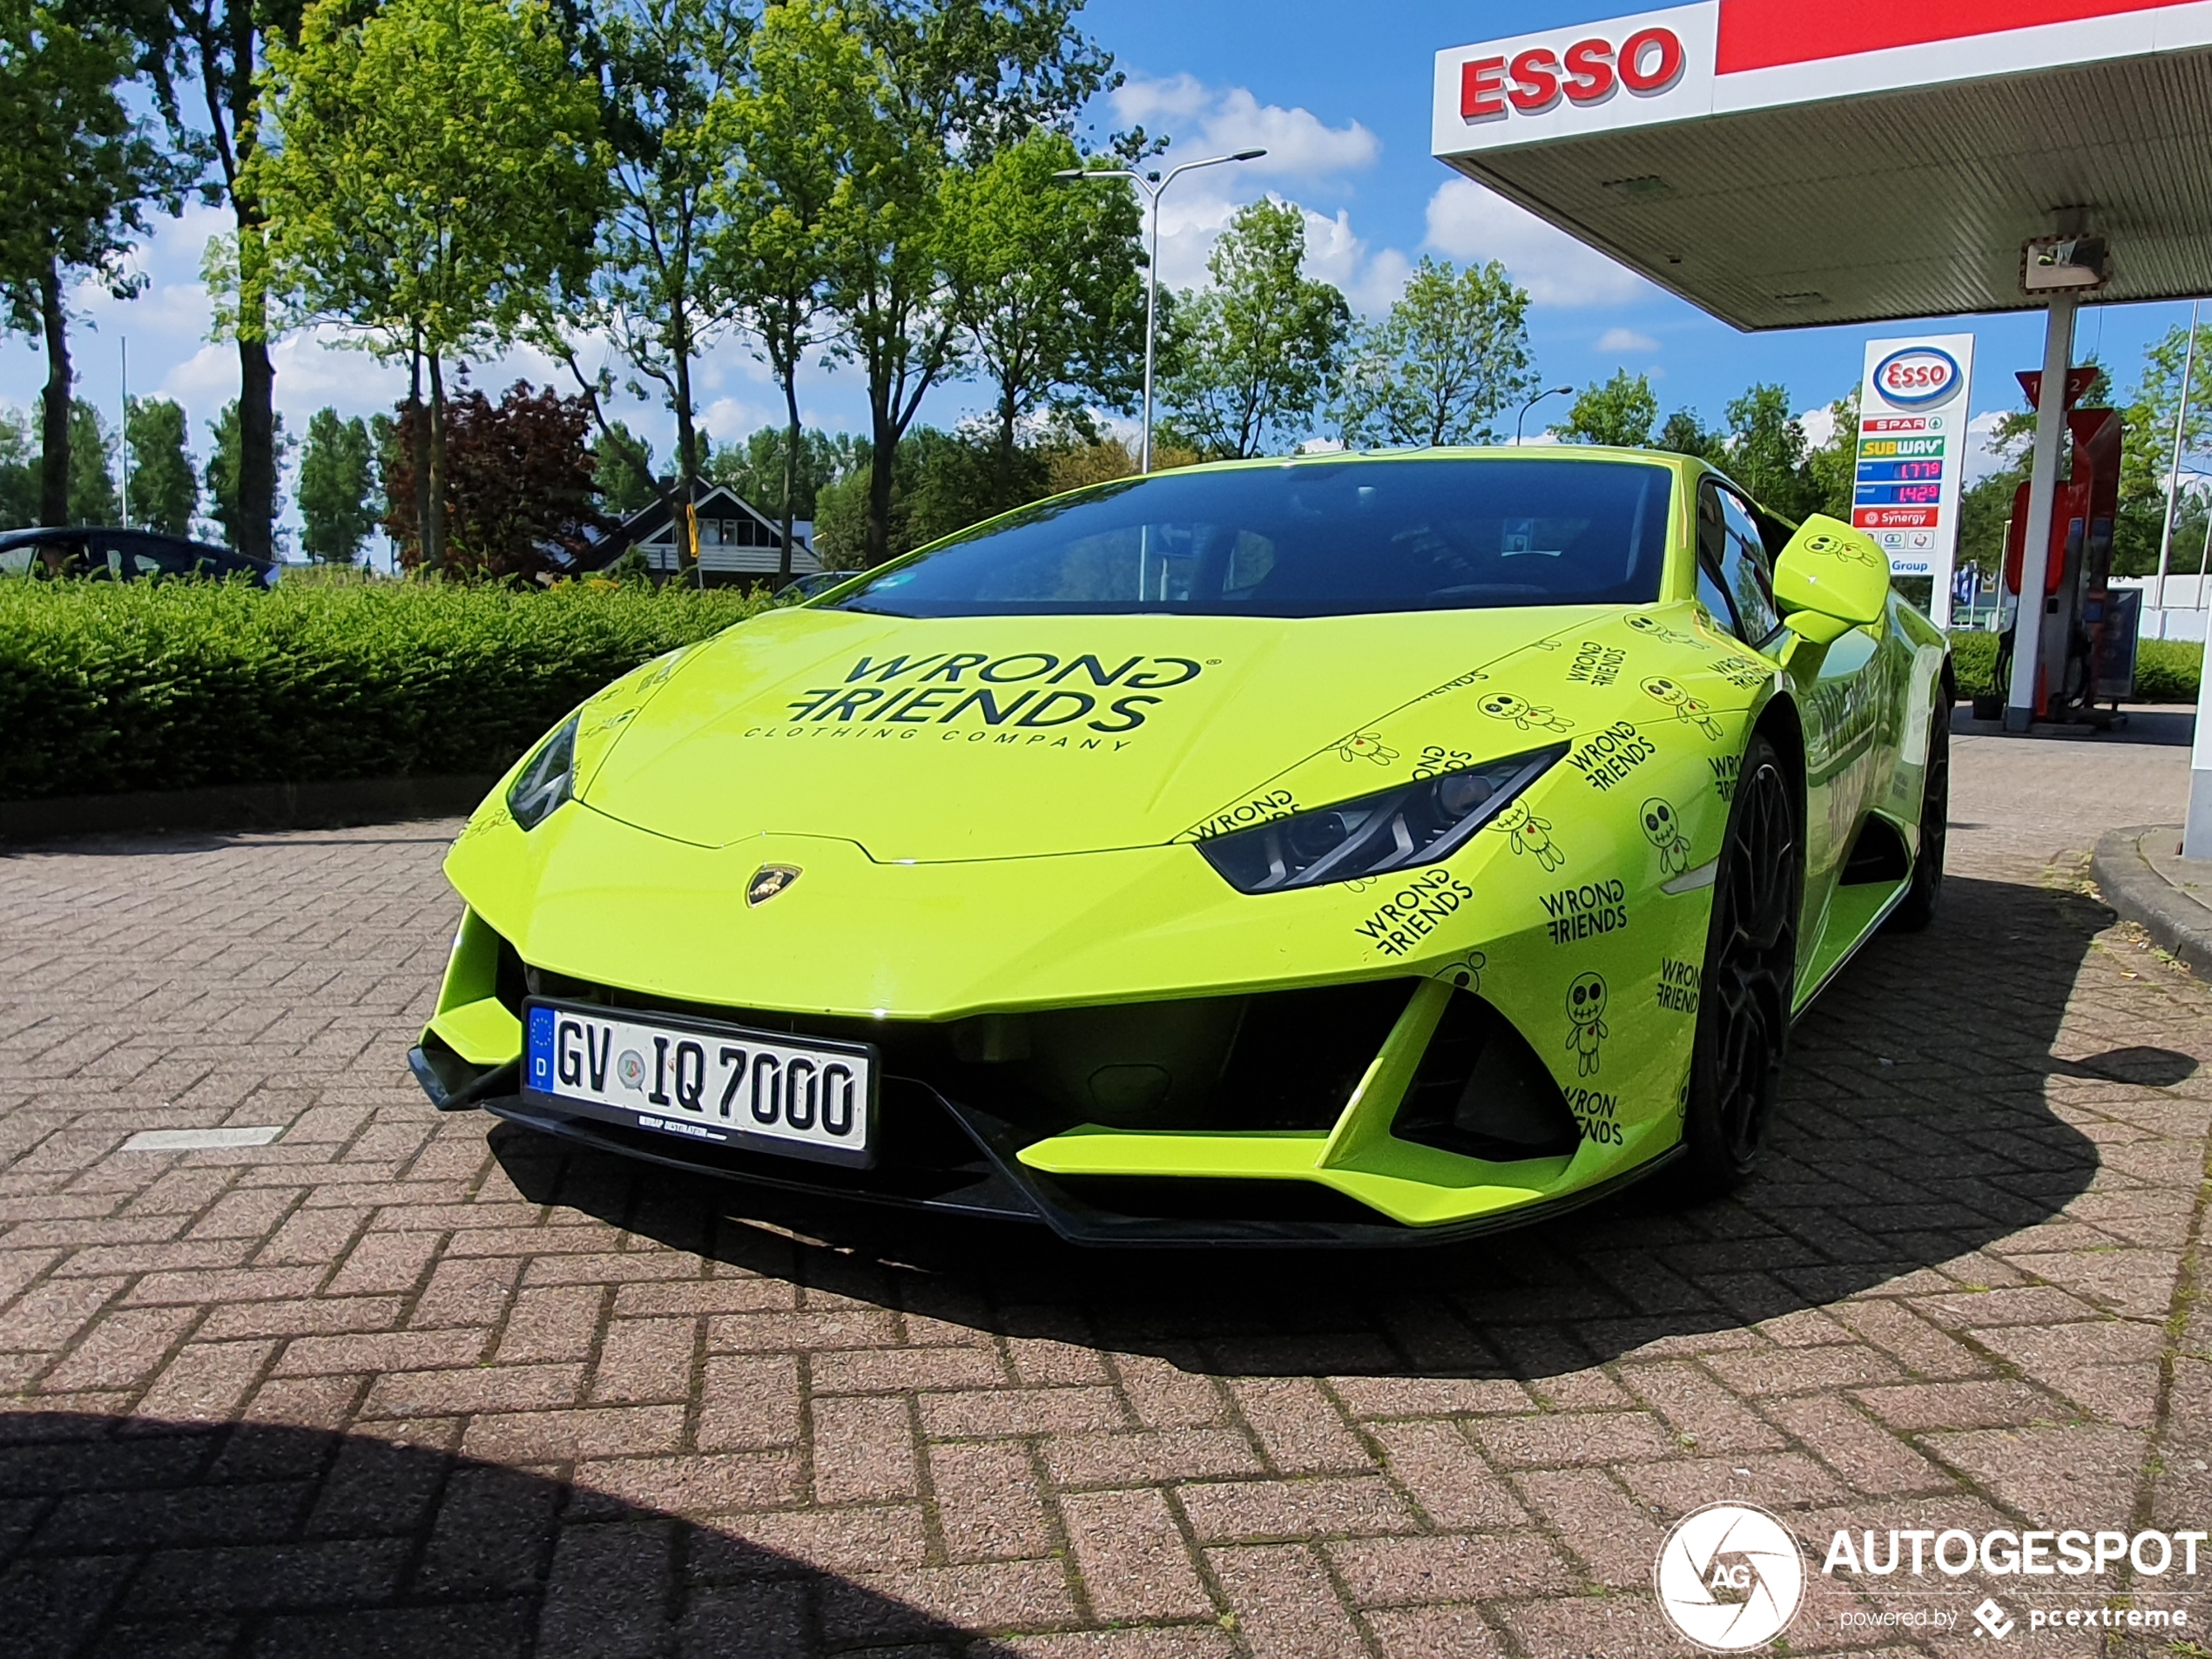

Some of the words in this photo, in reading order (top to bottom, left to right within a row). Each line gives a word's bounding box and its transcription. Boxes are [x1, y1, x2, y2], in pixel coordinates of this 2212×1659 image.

[1460, 27, 1683, 120] ESSO
[1887, 362, 1946, 387] Esso
[2031, 381, 2038, 395] 1
[2070, 378, 2080, 392] 2
[1877, 419, 1925, 430] SPAR
[1861, 439, 1943, 456] SUBWAY
[1882, 512, 1927, 525] Synergy
[1892, 560, 1928, 572] Group
[844, 652, 1202, 689] WRONG
[1566, 641, 1603, 681] WRONG
[1590, 647, 1627, 686] FRIENDS
[786, 687, 1163, 733] FRIENDS
[744, 727, 919, 739] CLOTHING
[942, 730, 1133, 752] COMPANY
[1566, 720, 1636, 773] WRONG
[1585, 736, 1656, 792] FRIENDS
[1708, 754, 1741, 778] WRO
[1354, 869, 1450, 940] WRONG
[1539, 879, 1625, 918] WRONG
[1376, 880, 1474, 956] FRIENDS
[1547, 905, 1628, 945] FRIENDS
[1662, 956, 1701, 990] WRON
[1656, 982, 1698, 1014] FRIEND
[536, 1057, 546, 1076] D
[558, 1020, 611, 1092] GV
[648, 1035, 705, 1113] IQ
[719, 1046, 855, 1136] 7000
